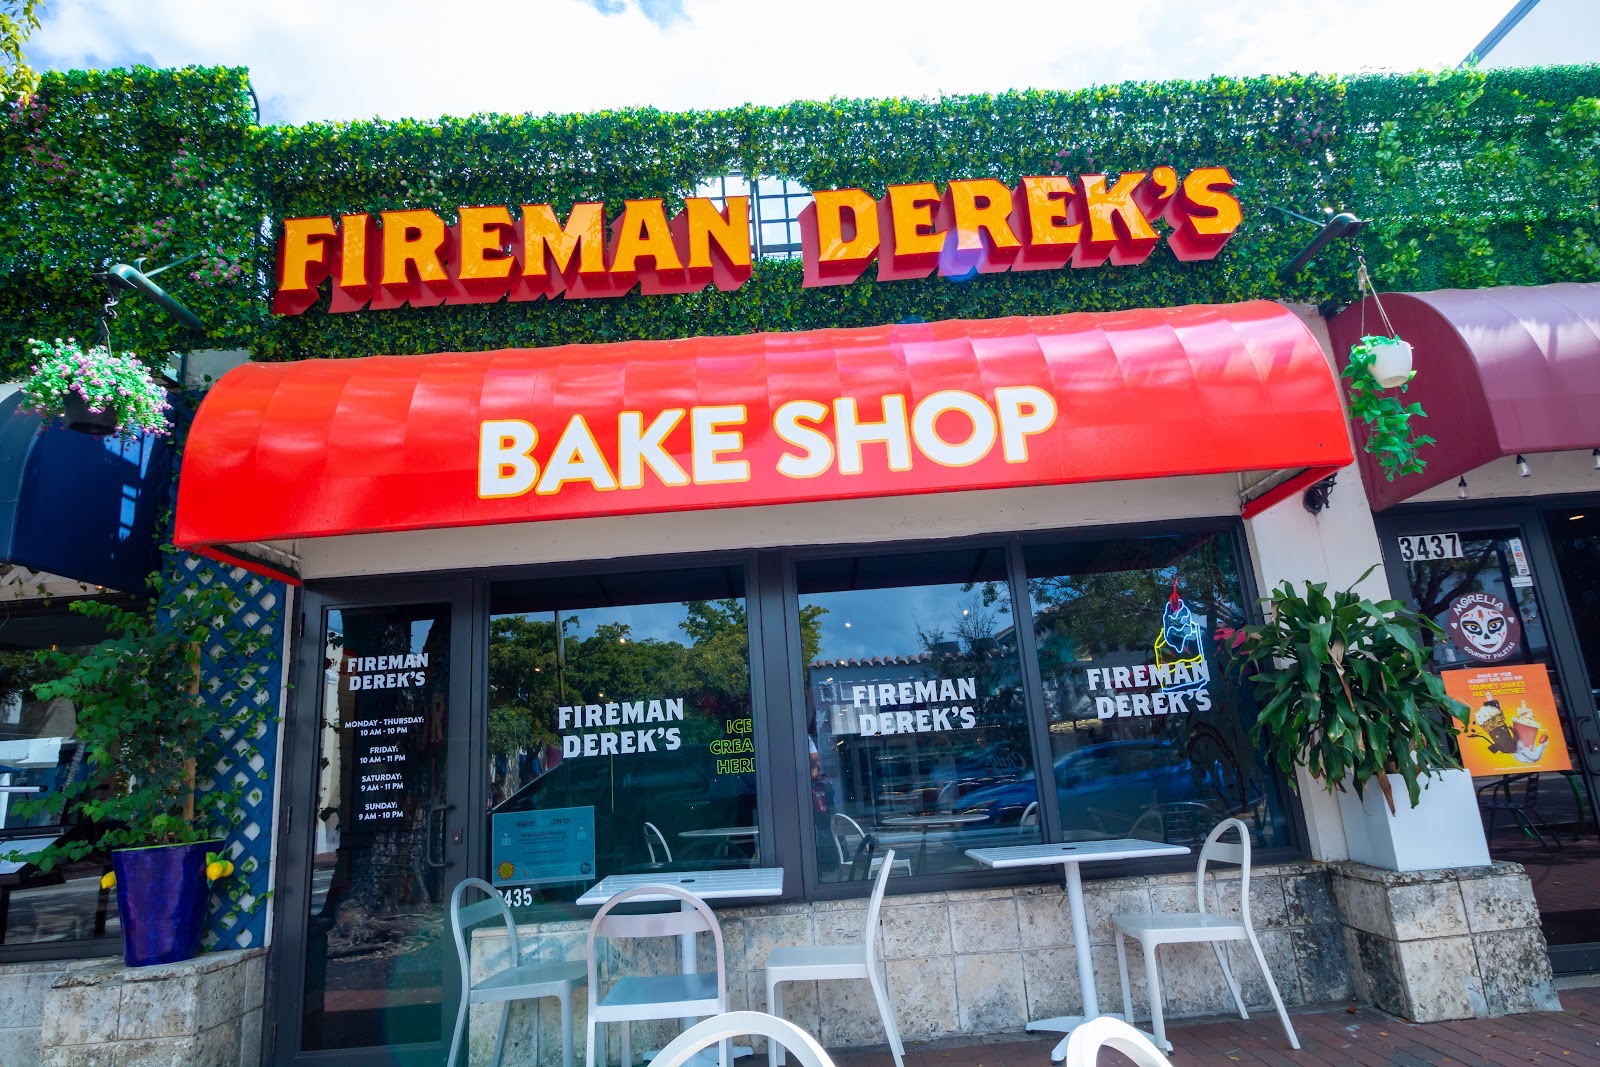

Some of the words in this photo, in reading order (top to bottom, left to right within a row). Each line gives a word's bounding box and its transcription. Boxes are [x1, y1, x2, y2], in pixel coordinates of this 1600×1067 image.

[277, 194, 752, 300] FIREMAN
[808, 165, 1244, 268] DEREK'S
[478, 404, 751, 499] BAKE
[773, 385, 1058, 478] SHOP
[1400, 534, 1458, 560] 3437
[1453, 593, 1505, 616] MORELIA
[1463, 645, 1491, 660] GOURMET
[1493, 641, 1516, 660] PALETAS
[347, 652, 429, 673] FIREMAN
[349, 671, 426, 691] DEREK'S
[1086, 660, 1211, 691] FIREMAN
[852, 677, 977, 708] FIREMAN
[1491, 687, 1526, 696] SMOOTHIES
[558, 697, 684, 730] FIREMAN
[1095, 688, 1212, 719] DEREK'S
[344, 719, 378, 728] MONDAY
[383, 716, 424, 726] THURSDAY:
[369, 728, 381, 736] AM
[387, 727, 395, 735] 10
[396, 726, 408, 734] PM
[726, 718, 752, 734] ICE
[859, 705, 977, 737] DEREK'S
[370, 745, 399, 754] FRIDAY:
[562, 726, 681, 759] DEREK'S
[709, 738, 755, 755] CREA
[361, 773, 402, 783] SATURDAY:
[392, 782, 404, 790] PM
[364, 812, 377, 820] AM
[382, 811, 391, 819] 10
[392, 810, 404, 818] PM
[365, 801, 398, 811] SUNDAY:
[497, 887, 533, 908] 435
